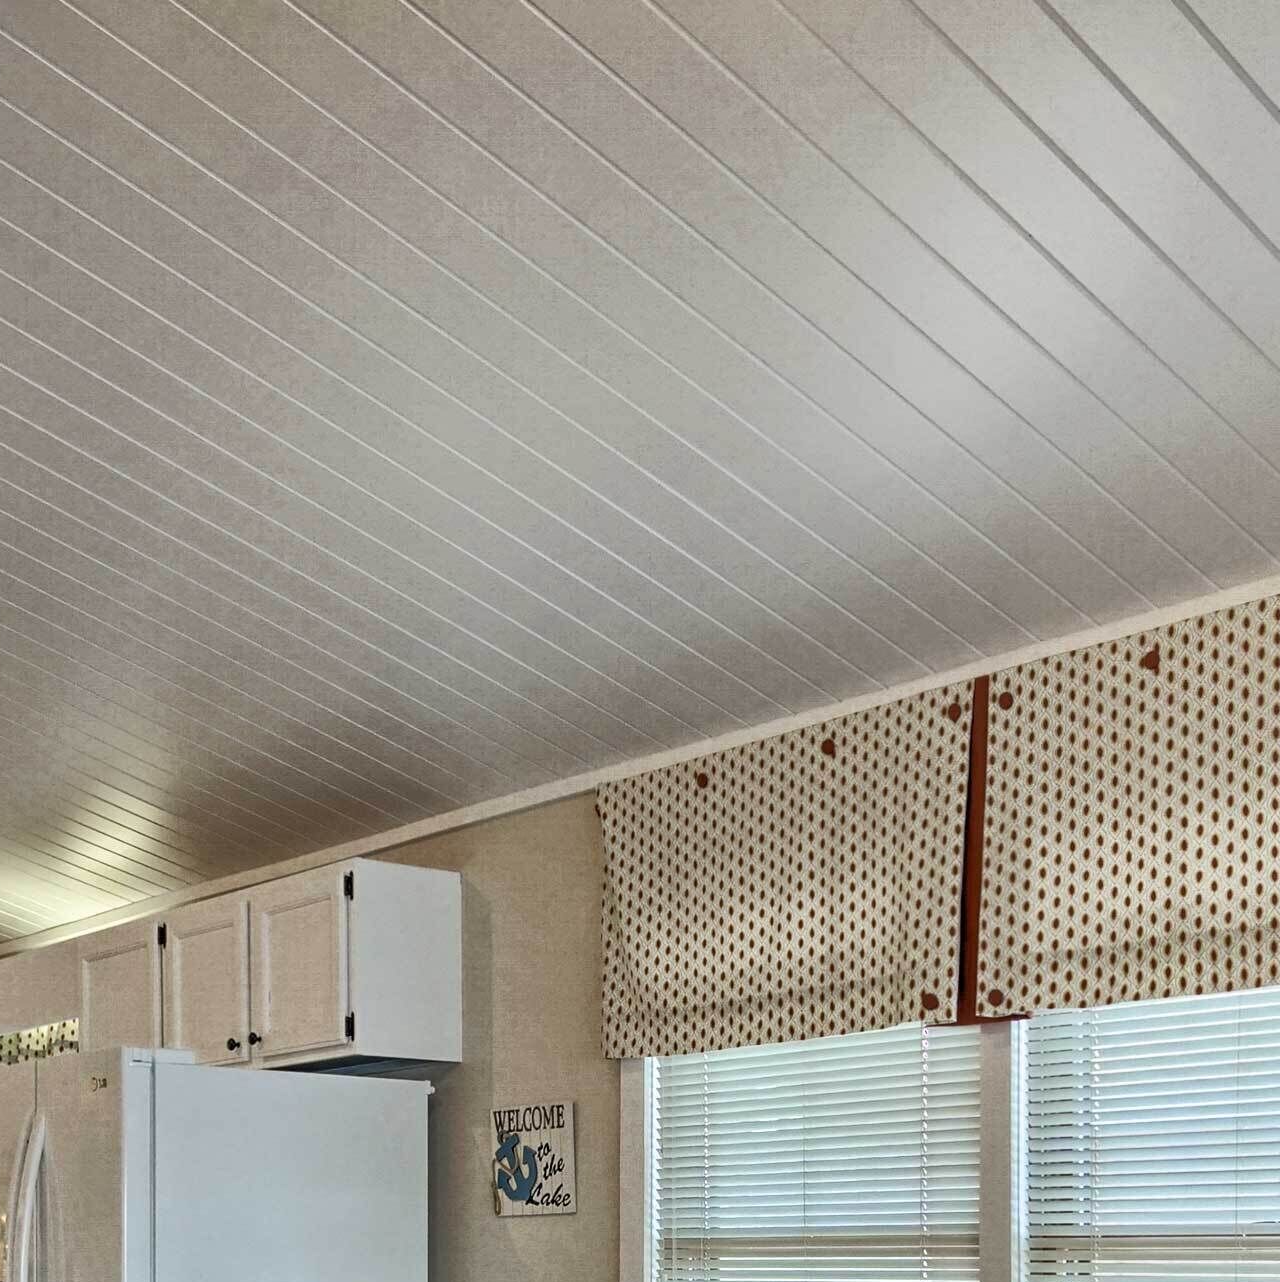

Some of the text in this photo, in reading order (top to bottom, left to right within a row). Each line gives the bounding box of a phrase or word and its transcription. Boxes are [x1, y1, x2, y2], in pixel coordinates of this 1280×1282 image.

[493, 1104, 565, 1133] WELCOME
[537, 1142, 551, 1162] to
[543, 1154, 565, 1181] the
[525, 1182, 571, 1207] Lake
